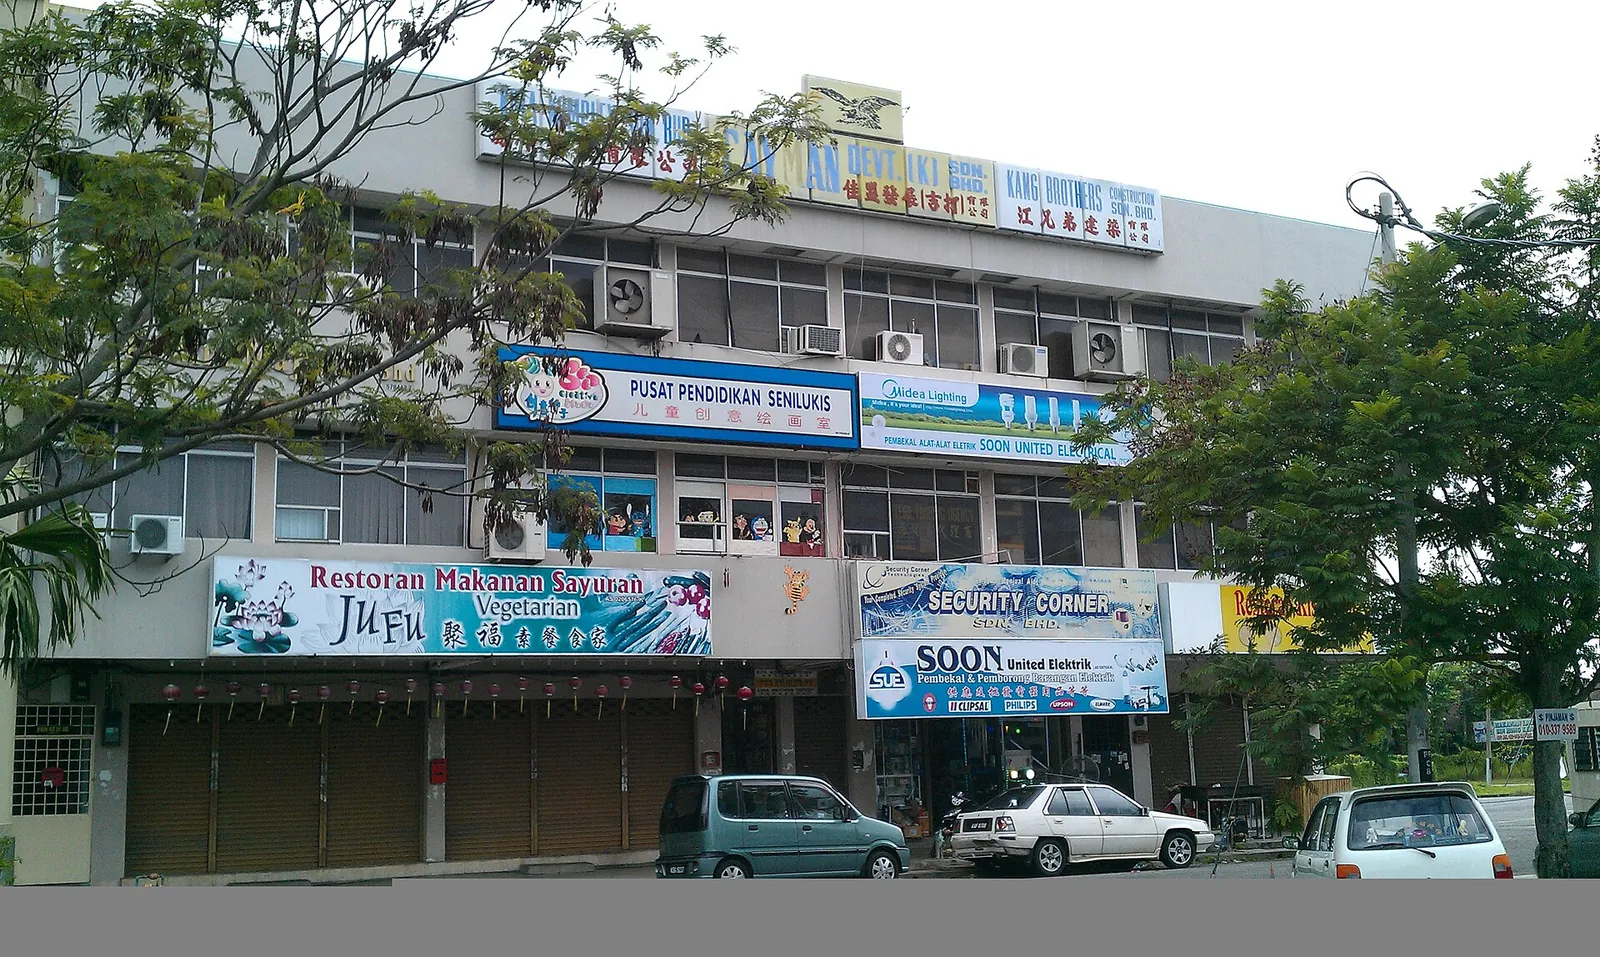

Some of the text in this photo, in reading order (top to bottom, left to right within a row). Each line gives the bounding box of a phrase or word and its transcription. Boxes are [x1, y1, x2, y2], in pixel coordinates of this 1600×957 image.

[848, 143, 902, 182] DEVT.
[948, 159, 988, 179] SDN.
[949, 175, 988, 195] BHD.
[1006, 169, 1103, 213] KANG BROTHERS
[1109, 187, 1155, 207] CONSTRUCTION
[1111, 203, 1157, 222] SDN. BHD.
[630, 379, 831, 412] PUSAT PENDIDIKAN SENILUKIS
[885, 383, 968, 405] Midea Lighting
[632, 402, 832, 430] 儿童创意绘画室
[884, 436, 917, 447] PEMBEKAL
[919, 439, 951, 449] ALAT-ALAT
[952, 441, 977, 451] ELETRIK
[979, 438, 1011, 454] SOON
[1015, 441, 1054, 456] UNITED
[1057, 444, 1117, 461] ELECTRICAL
[310, 564, 644, 596] Restoran Makanan Sayuran
[885, 566, 910, 574] Security
[476, 594, 580, 621] Vegetarian
[928, 590, 1109, 616] SECURITY CORNER
[916, 644, 1004, 672] SOON
[1007, 658, 1047, 670] United
[1049, 658, 1093, 671] Elektrik
[868, 673, 906, 688] SUE
[916, 671, 1115, 687] Pembekal & Pemborong Barangan Elektrik
[958, 701, 990, 712] CLIPSAL
[1005, 700, 1037, 711] PHILIPS
[1051, 700, 1074, 709] UPSON
